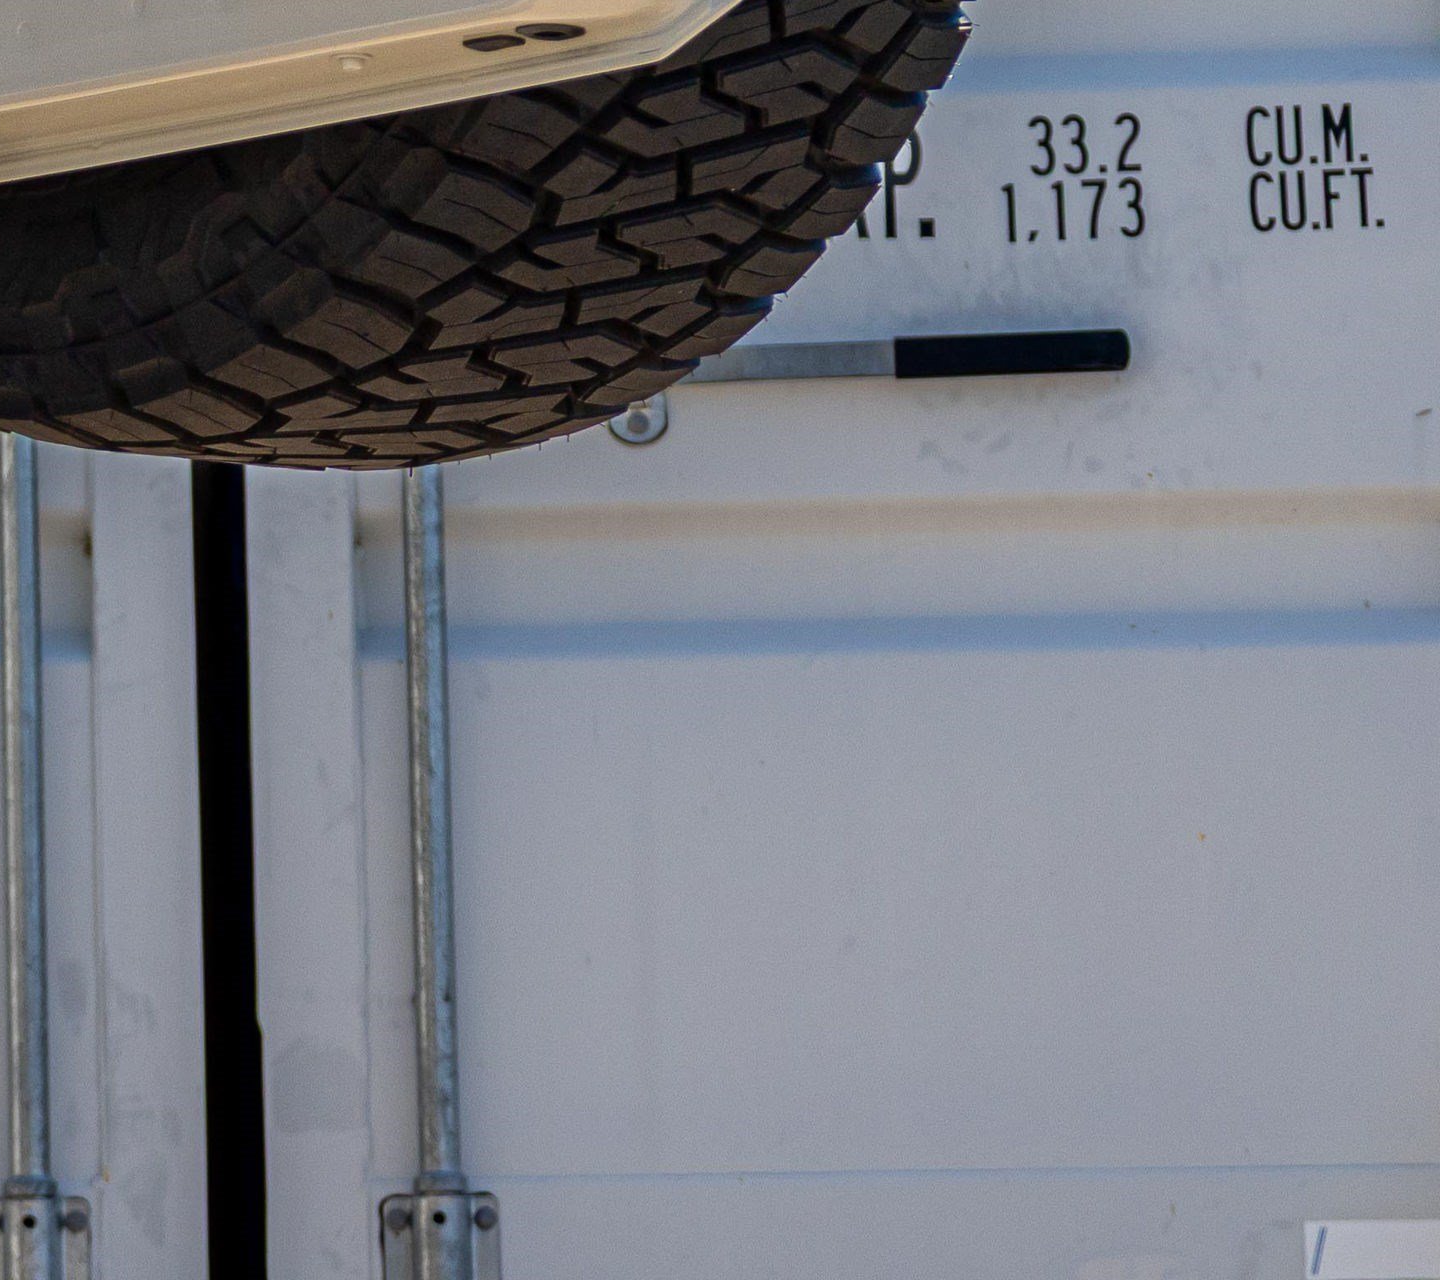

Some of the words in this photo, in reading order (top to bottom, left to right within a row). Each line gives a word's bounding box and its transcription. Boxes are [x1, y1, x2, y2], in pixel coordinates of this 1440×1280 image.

[1028, 113, 1143, 176] 33.2
[1246, 103, 1370, 167] CU.M.
[1001, 177, 1145, 242] 1,173
[1248, 168, 1385, 232] CU.FT.
